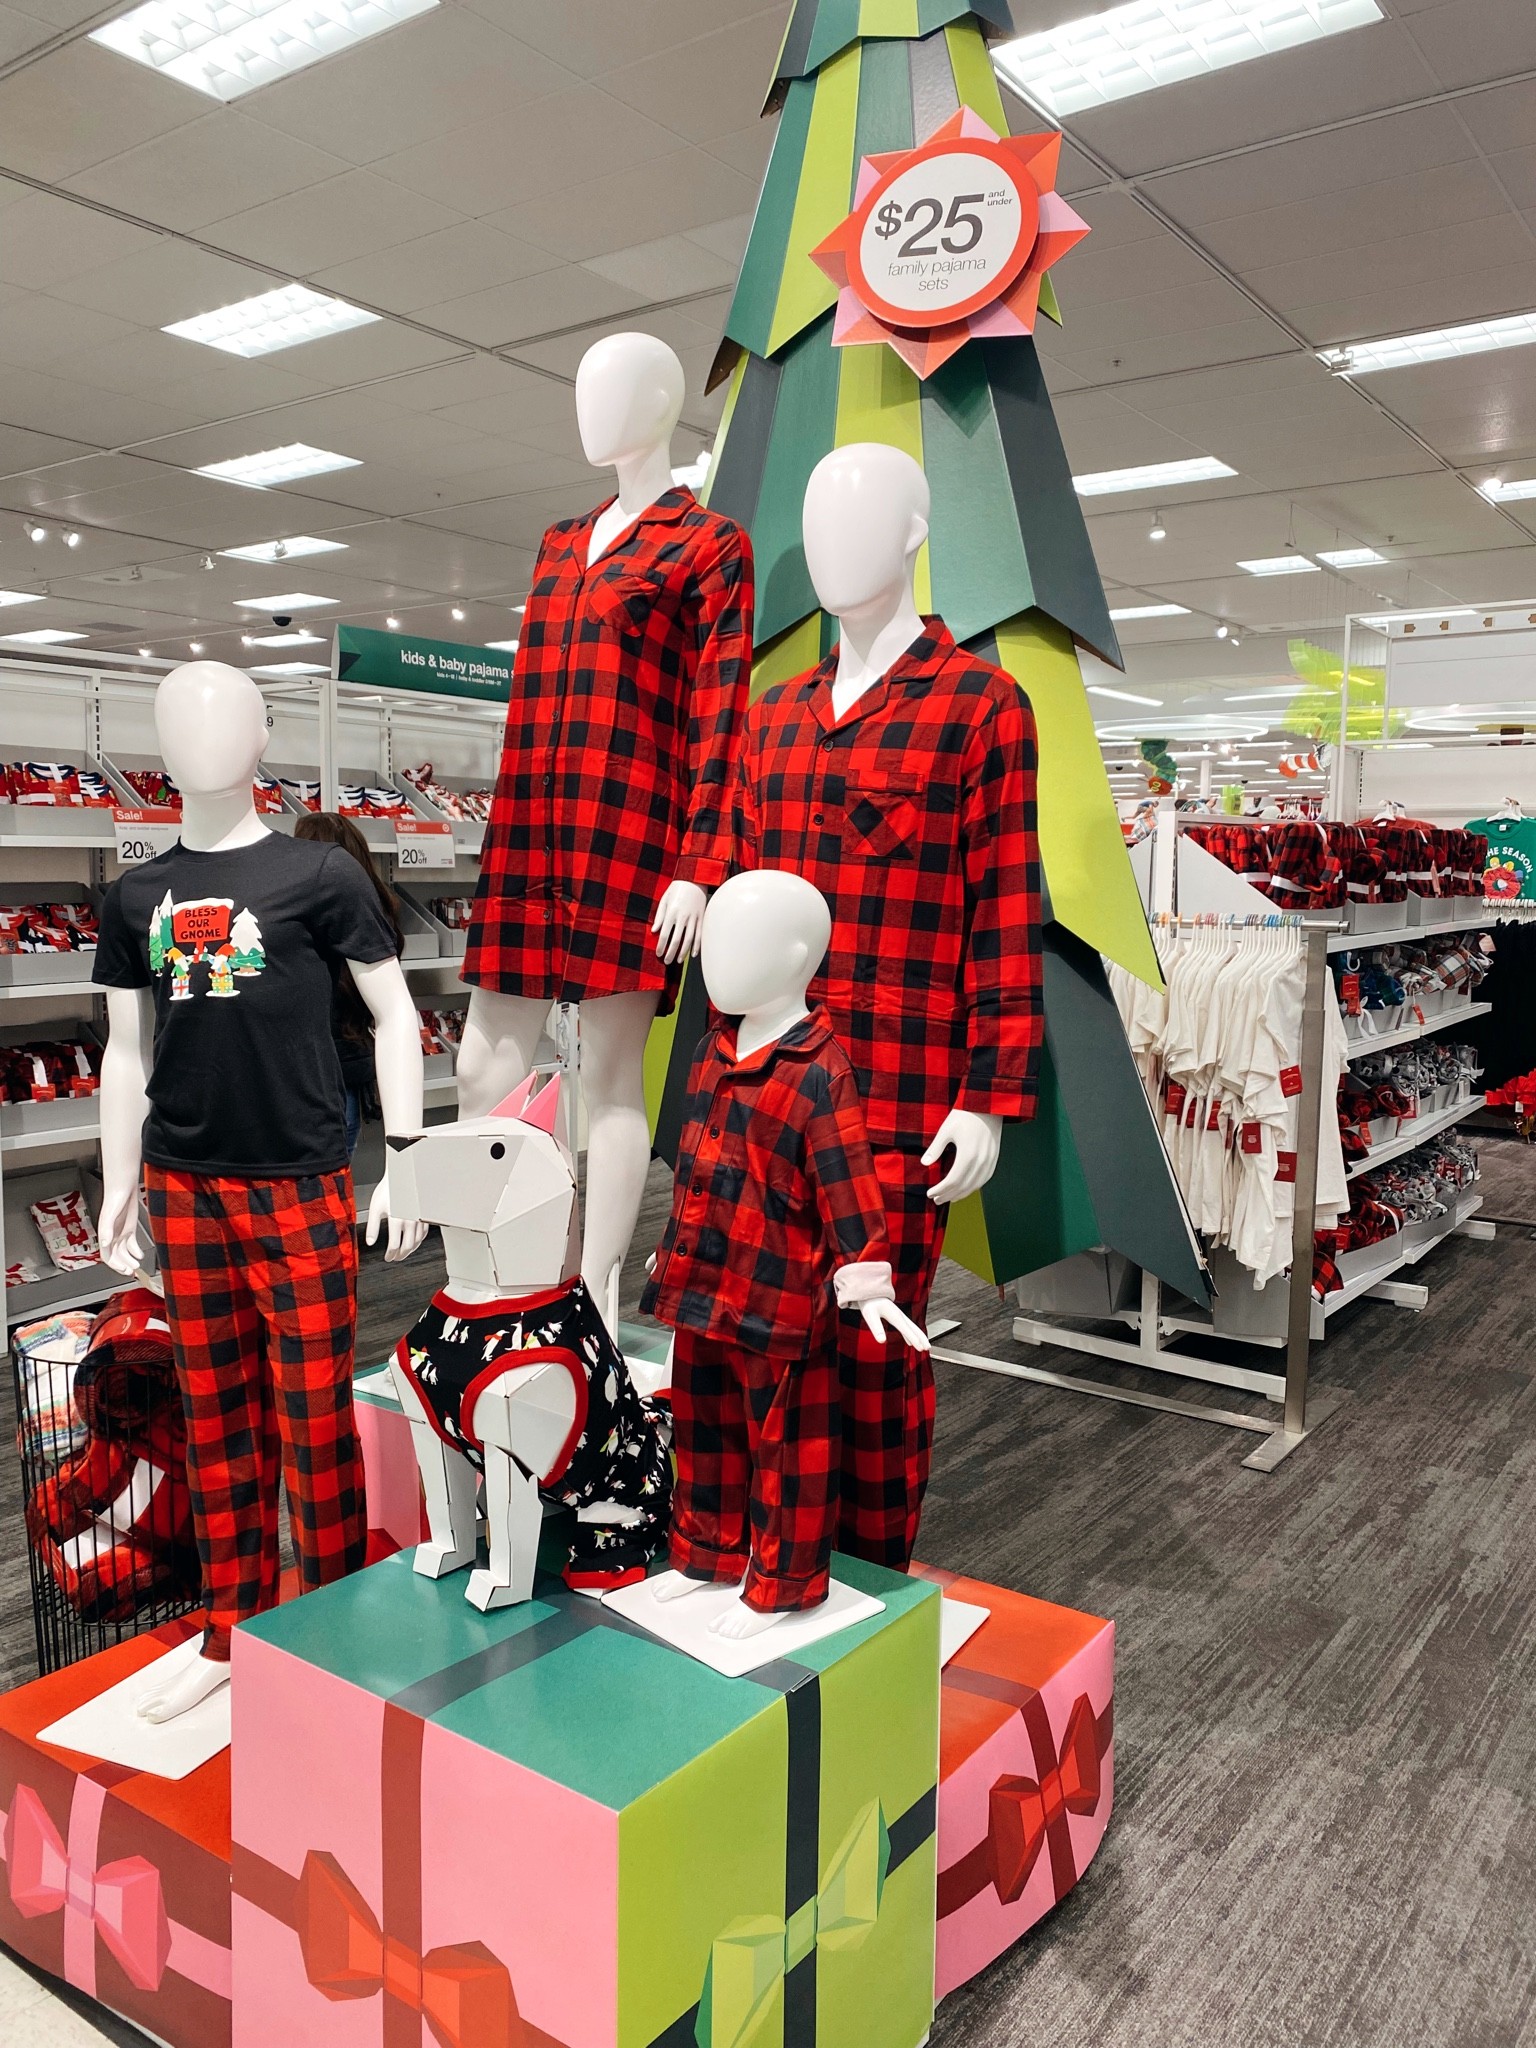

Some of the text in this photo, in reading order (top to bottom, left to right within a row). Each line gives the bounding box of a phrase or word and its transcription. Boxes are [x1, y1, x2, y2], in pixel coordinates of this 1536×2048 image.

[987, 189, 1006, 198] and
[986, 197, 1013, 207] under
[874, 192, 985, 258] $25
[887, 257, 987, 278] family pajama
[918, 277, 949, 292] sets
[401, 649, 426, 665] kids
[428, 654, 437, 668] &
[439, 655, 467, 675] baby
[469, 662, 509, 680] pajama
[116, 810, 144, 821] Sale!
[396, 822, 417, 832] Sale!
[144, 850, 157, 859] off
[1486, 846, 1534, 873] HE SEASON
[418, 857, 428, 865] off
[184, 907, 218, 919] BLESS
[187, 918, 210, 929] OUR
[180, 928, 222, 940] GNOME
